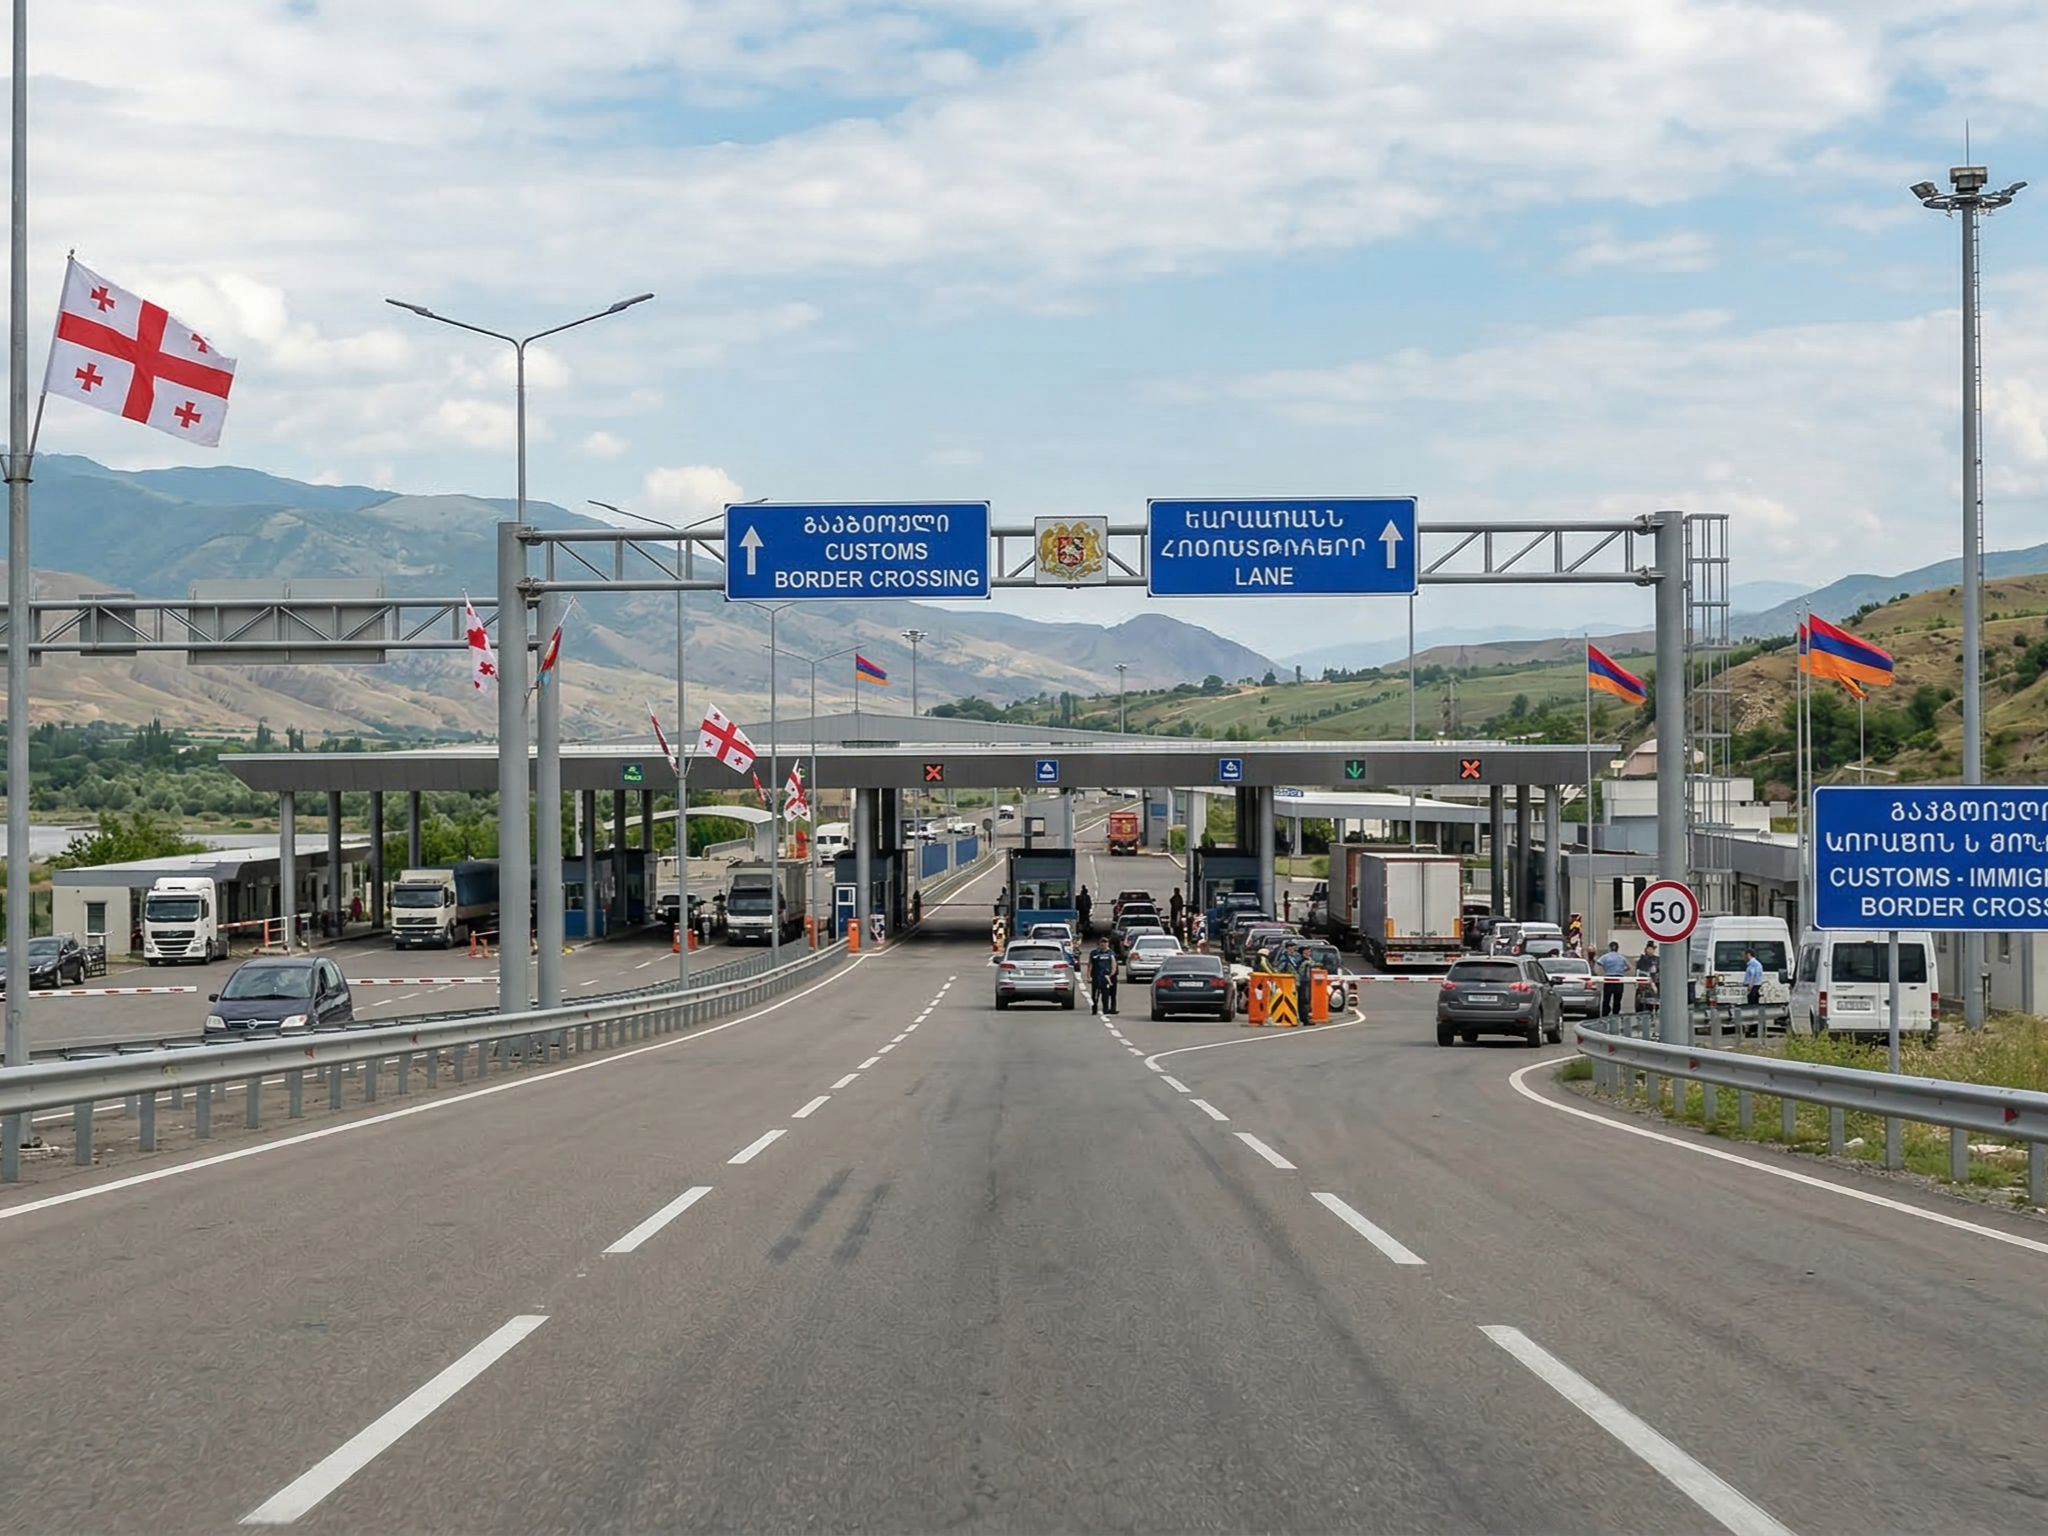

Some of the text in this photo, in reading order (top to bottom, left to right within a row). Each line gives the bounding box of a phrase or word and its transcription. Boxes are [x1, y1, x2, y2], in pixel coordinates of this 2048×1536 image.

[825, 542, 928, 561] CUSTOMS
[774, 569, 980, 589] BORDER CROSSING
[1235, 566, 1294, 586] LANE
[1829, 866, 1951, 887] CUSTOMS
[1650, 901, 1686, 924] 50
[1861, 896, 1965, 917] BORDER
